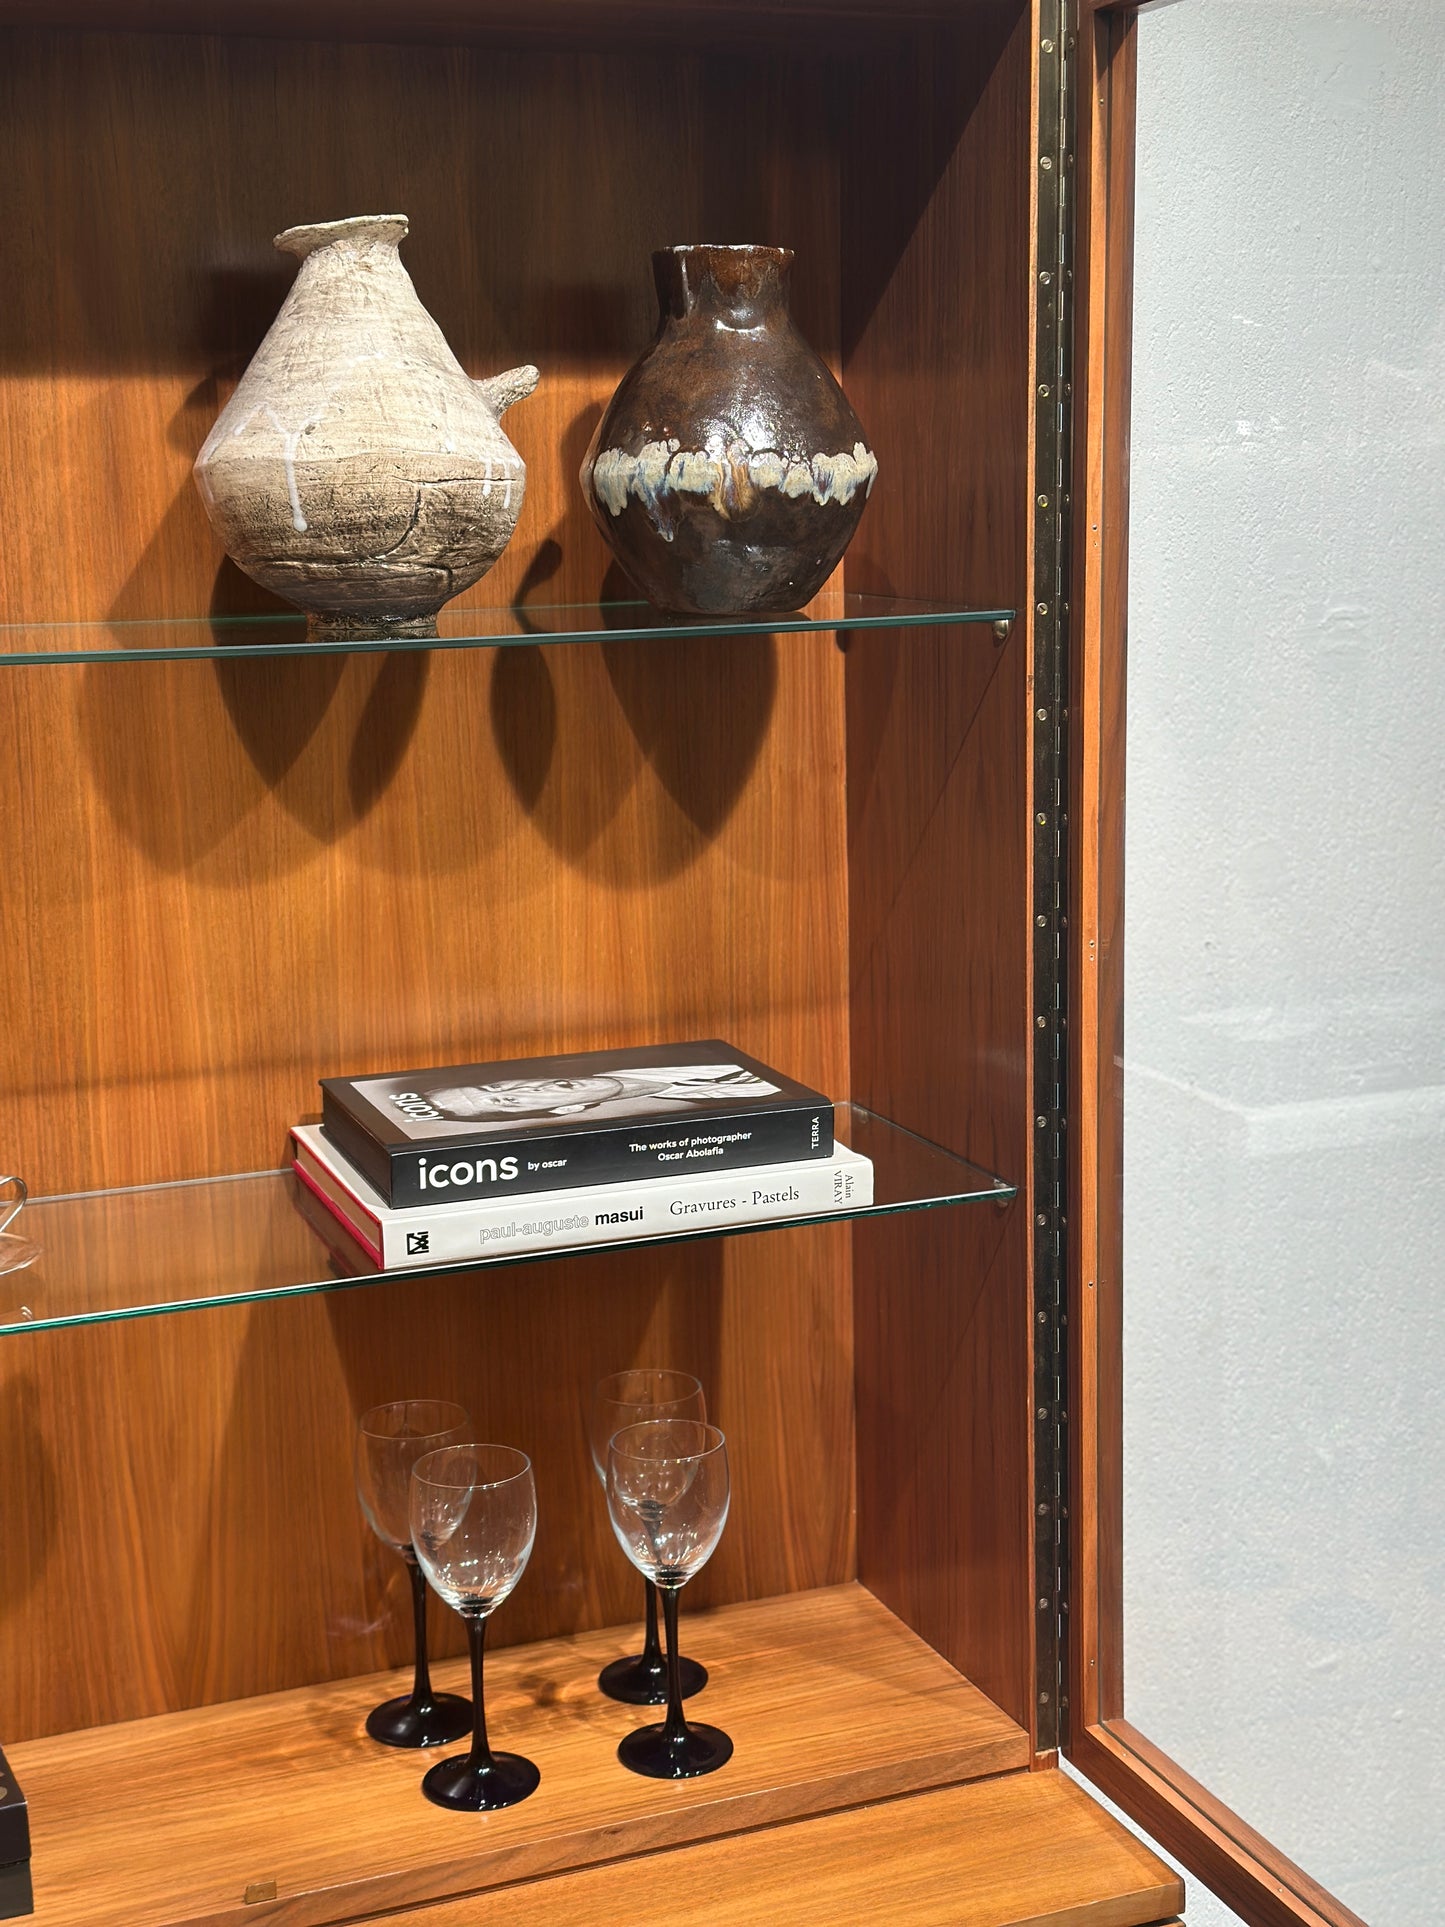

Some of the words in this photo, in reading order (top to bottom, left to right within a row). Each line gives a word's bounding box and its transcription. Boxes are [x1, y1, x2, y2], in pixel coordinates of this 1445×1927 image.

[389, 1093, 444, 1122] icons
[629, 1143, 647, 1153] The
[649, 1138, 677, 1150] works
[678, 1137, 689, 1147] of
[690, 1132, 752, 1147] photographer
[811, 1116, 819, 1149] TERRA
[657, 1152, 684, 1162] Oscar
[686, 1146, 724, 1158] Abolafia
[418, 1157, 519, 1190] icons
[527, 1161, 540, 1172] by
[542, 1159, 567, 1169] oscar
[834, 1170, 843, 1204] VIRAY
[845, 1174, 854, 1198] Alain
[669, 1198, 736, 1216] Gravures
[752, 1186, 800, 1206] Pastels
[479, 1214, 590, 1245] paul-auguste
[595, 1206, 644, 1226] masui
